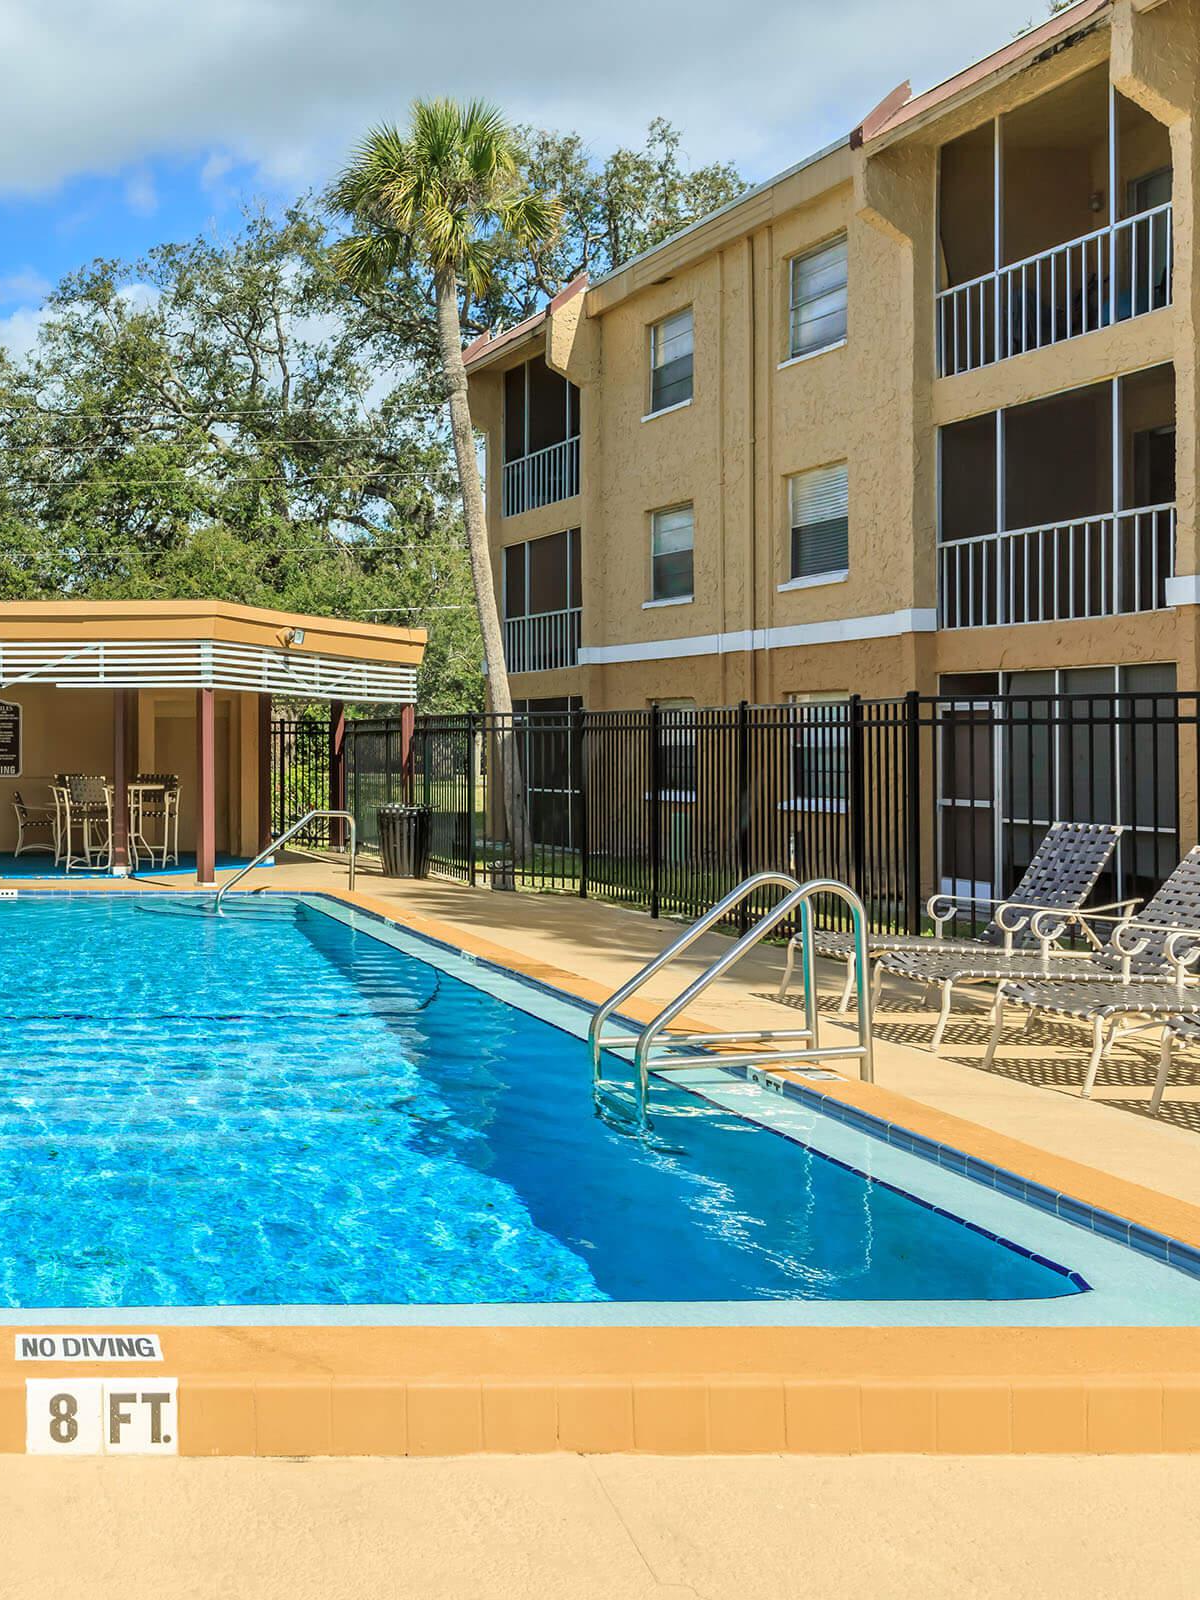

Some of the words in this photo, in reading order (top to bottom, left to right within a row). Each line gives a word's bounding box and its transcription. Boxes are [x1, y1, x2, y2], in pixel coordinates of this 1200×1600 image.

[22, 1337, 56, 1357] NO
[62, 1337, 156, 1357] DIVING
[49, 1393, 78, 1444] 8
[109, 1392, 172, 1444] FT.
